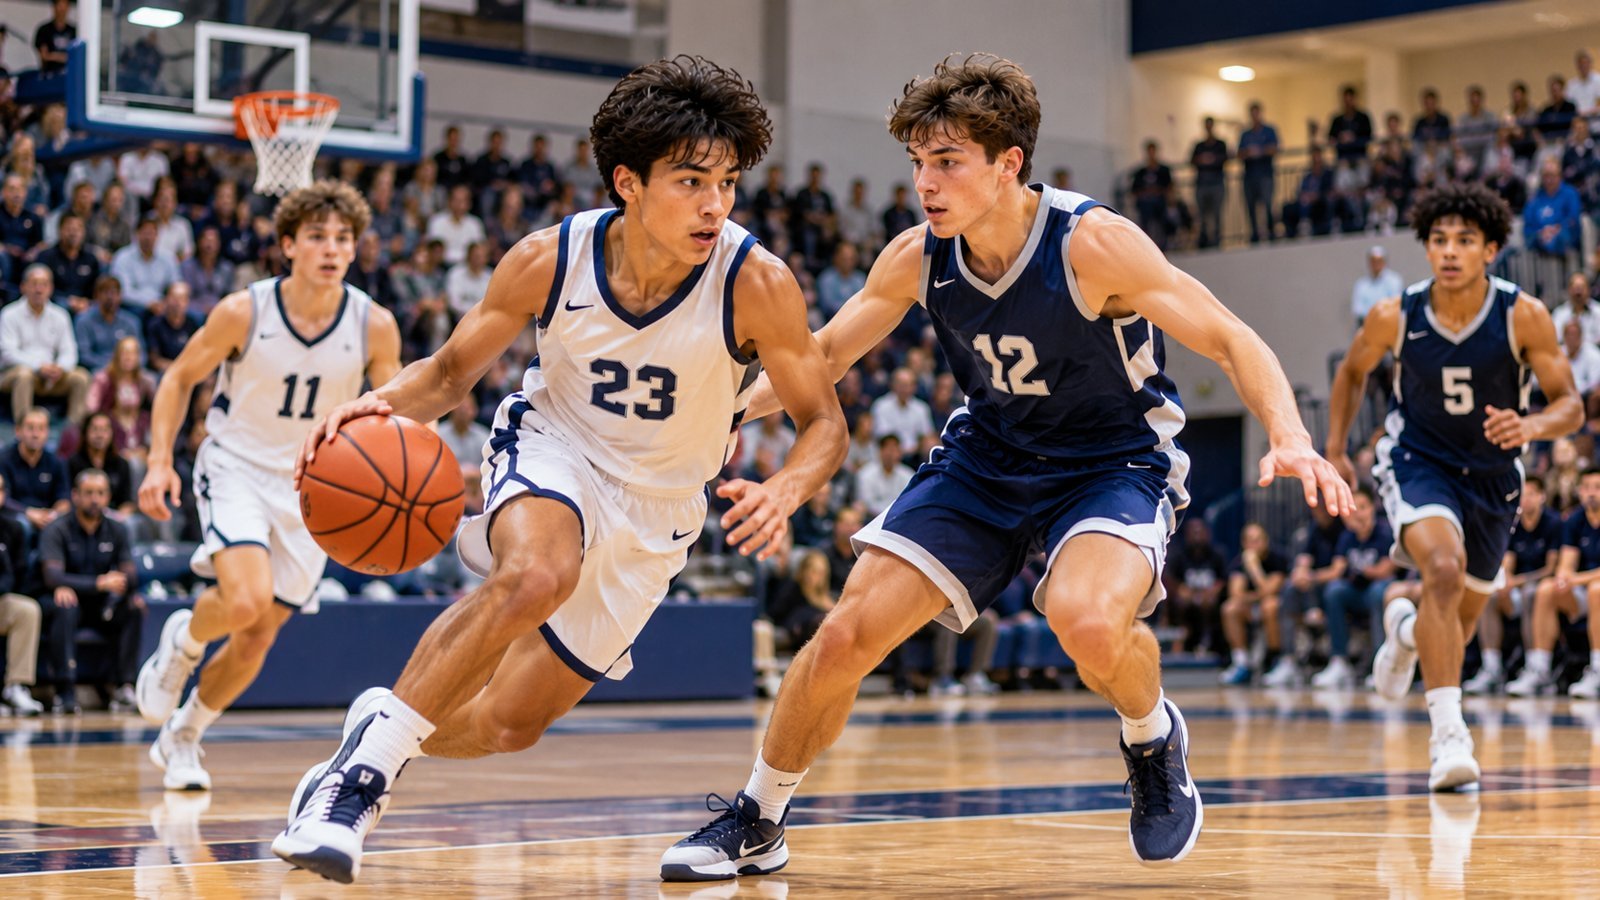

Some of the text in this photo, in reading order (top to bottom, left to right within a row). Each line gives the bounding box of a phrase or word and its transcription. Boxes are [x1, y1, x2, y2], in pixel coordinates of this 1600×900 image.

[589, 358, 677, 421] 23
[972, 334, 1051, 396] 12
[1441, 366, 1475, 416] 5
[278, 374, 321, 419] 11
